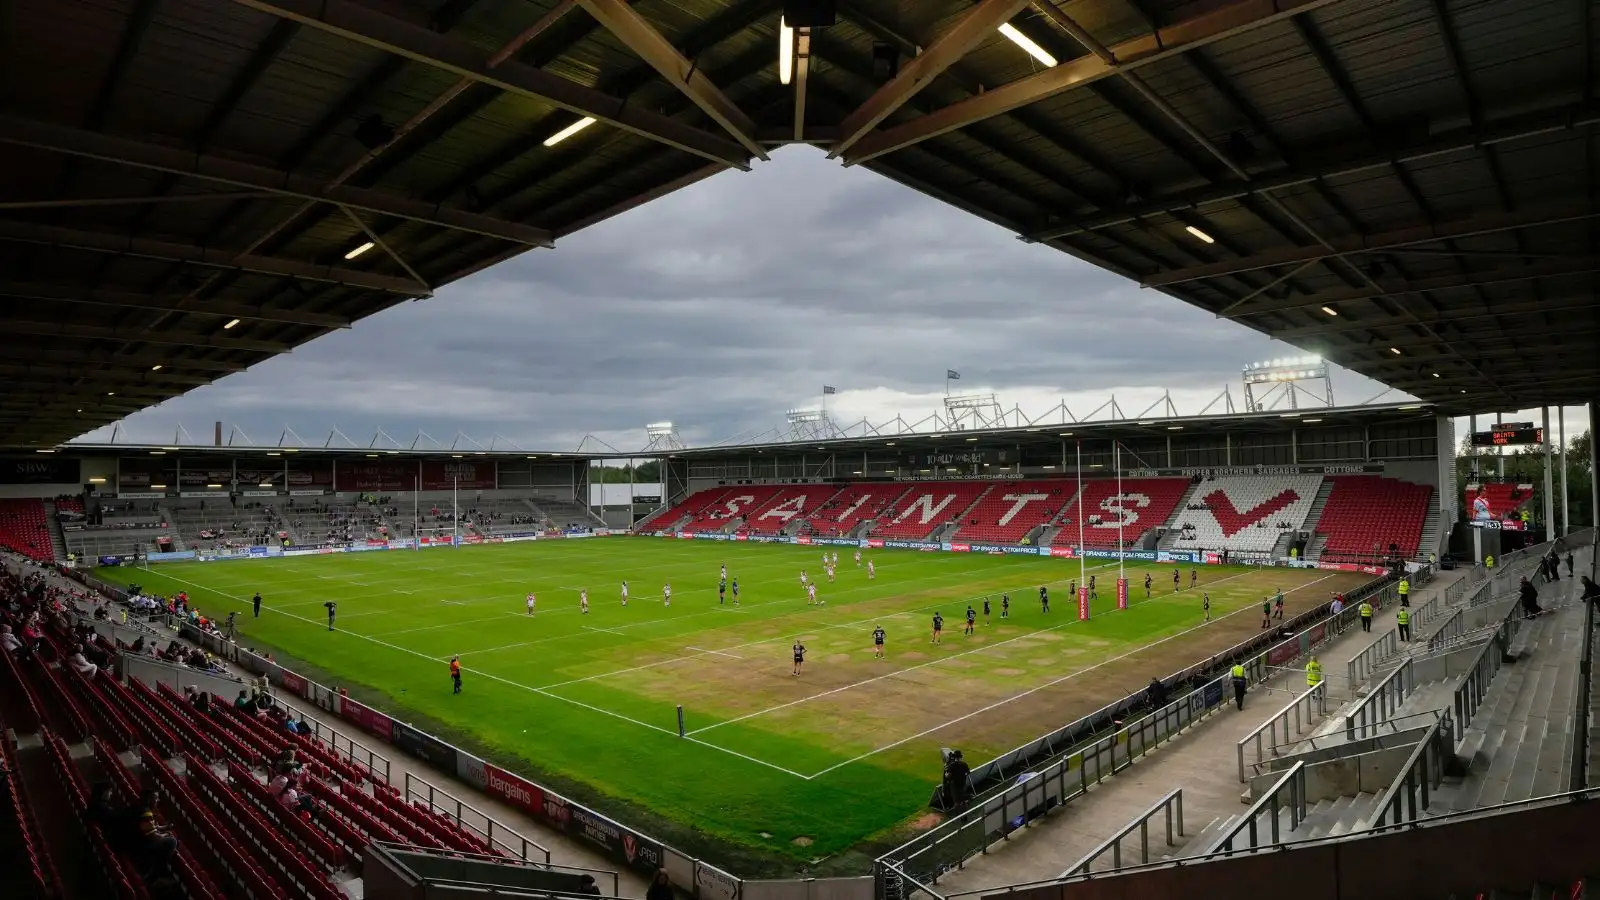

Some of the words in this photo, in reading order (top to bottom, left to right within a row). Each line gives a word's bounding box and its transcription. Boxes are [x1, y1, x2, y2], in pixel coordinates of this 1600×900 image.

[1215, 468, 1254, 476] NORTHERN
[1258, 466, 1300, 474] SAUSAGES
[1324, 465, 1364, 474] COTTOMS
[710, 493, 1150, 528] SAINTS
[490, 771, 530, 804] bargains
